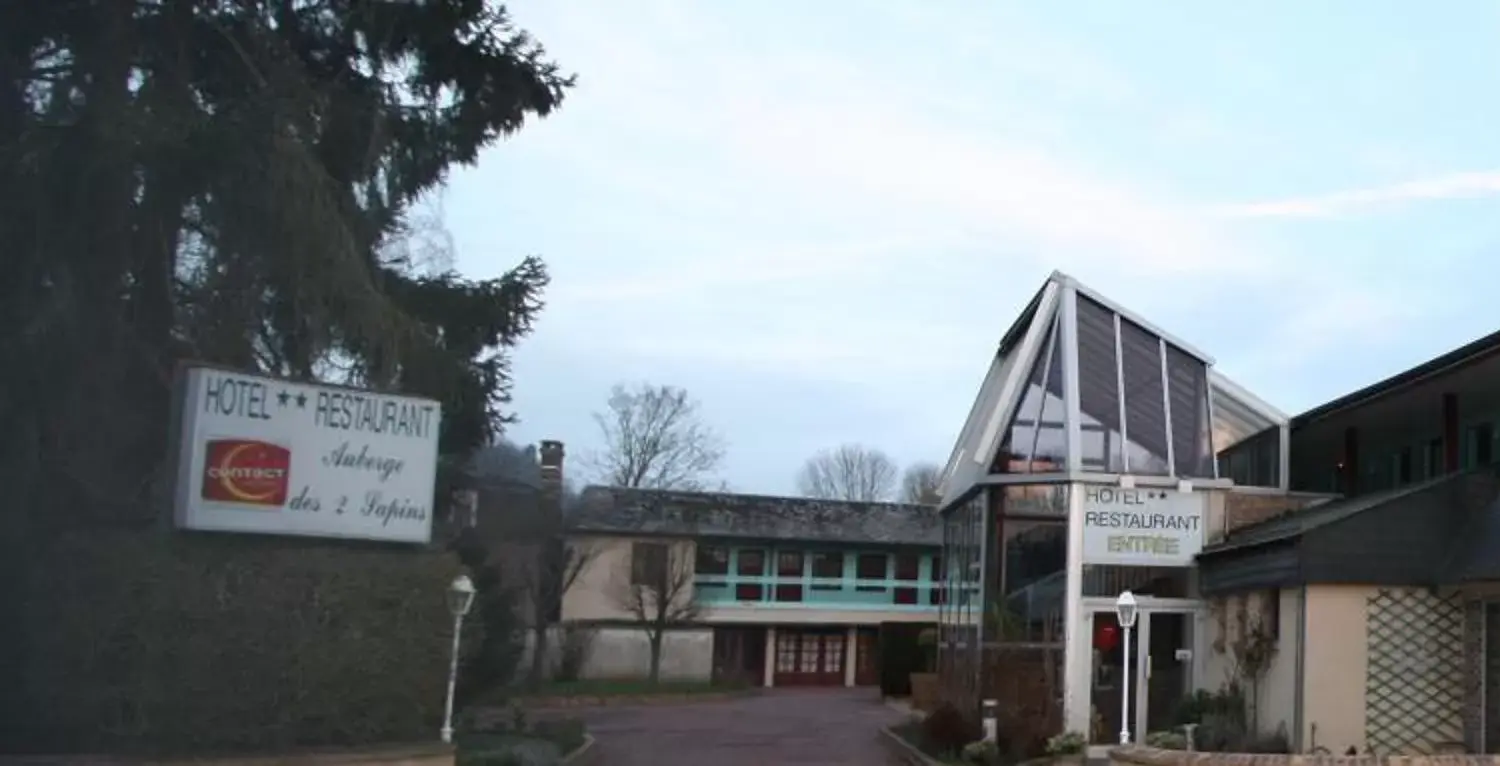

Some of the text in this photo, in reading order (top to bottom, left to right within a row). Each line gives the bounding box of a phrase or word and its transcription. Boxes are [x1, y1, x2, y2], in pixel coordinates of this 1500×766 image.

[204, 377, 433, 438] HOTEL RESTAURANT
[321, 442, 404, 482] Auberge
[289, 486, 427, 526] des 2 Sapins
[1086, 488, 1144, 505] HOTEL
[1085, 511, 1200, 530] RESTAURANT
